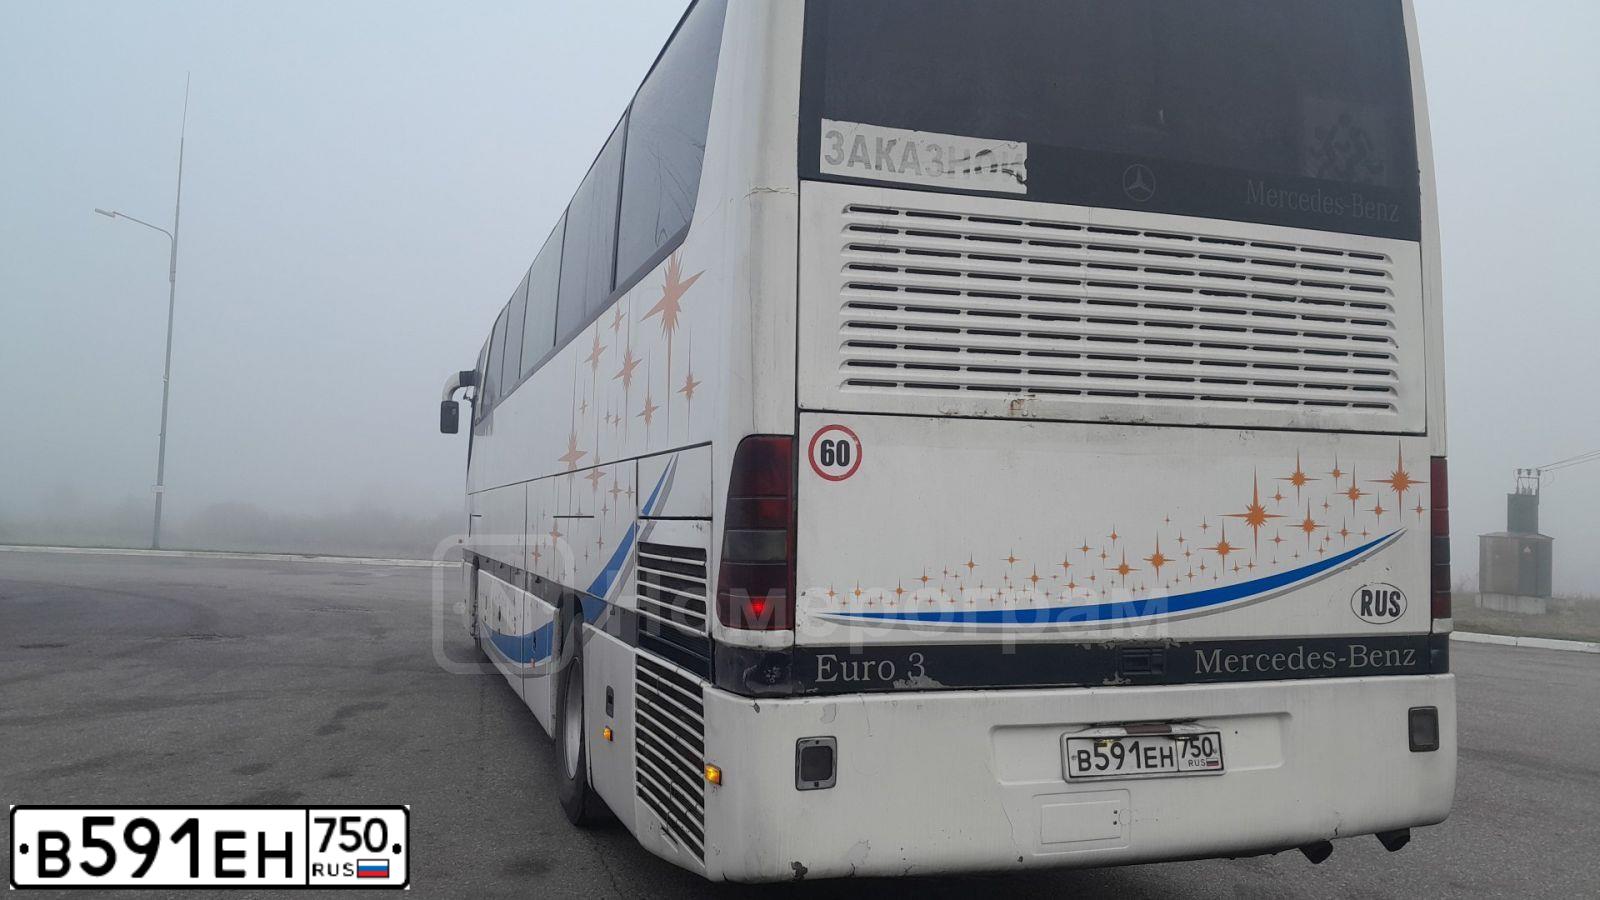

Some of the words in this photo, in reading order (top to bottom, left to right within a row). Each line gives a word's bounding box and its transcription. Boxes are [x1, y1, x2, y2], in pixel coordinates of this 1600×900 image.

[1246, 179, 1401, 223] Mercedes-Benz
[820, 439, 851, 467] 60
[1359, 588, 1402, 618] RUS
[815, 653, 897, 684] Euro
[907, 652, 926, 679] 3
[1194, 644, 1417, 675] Mercedes-Benz
[1178, 736, 1213, 759] 750
[1188, 759, 1206, 767] RUS
